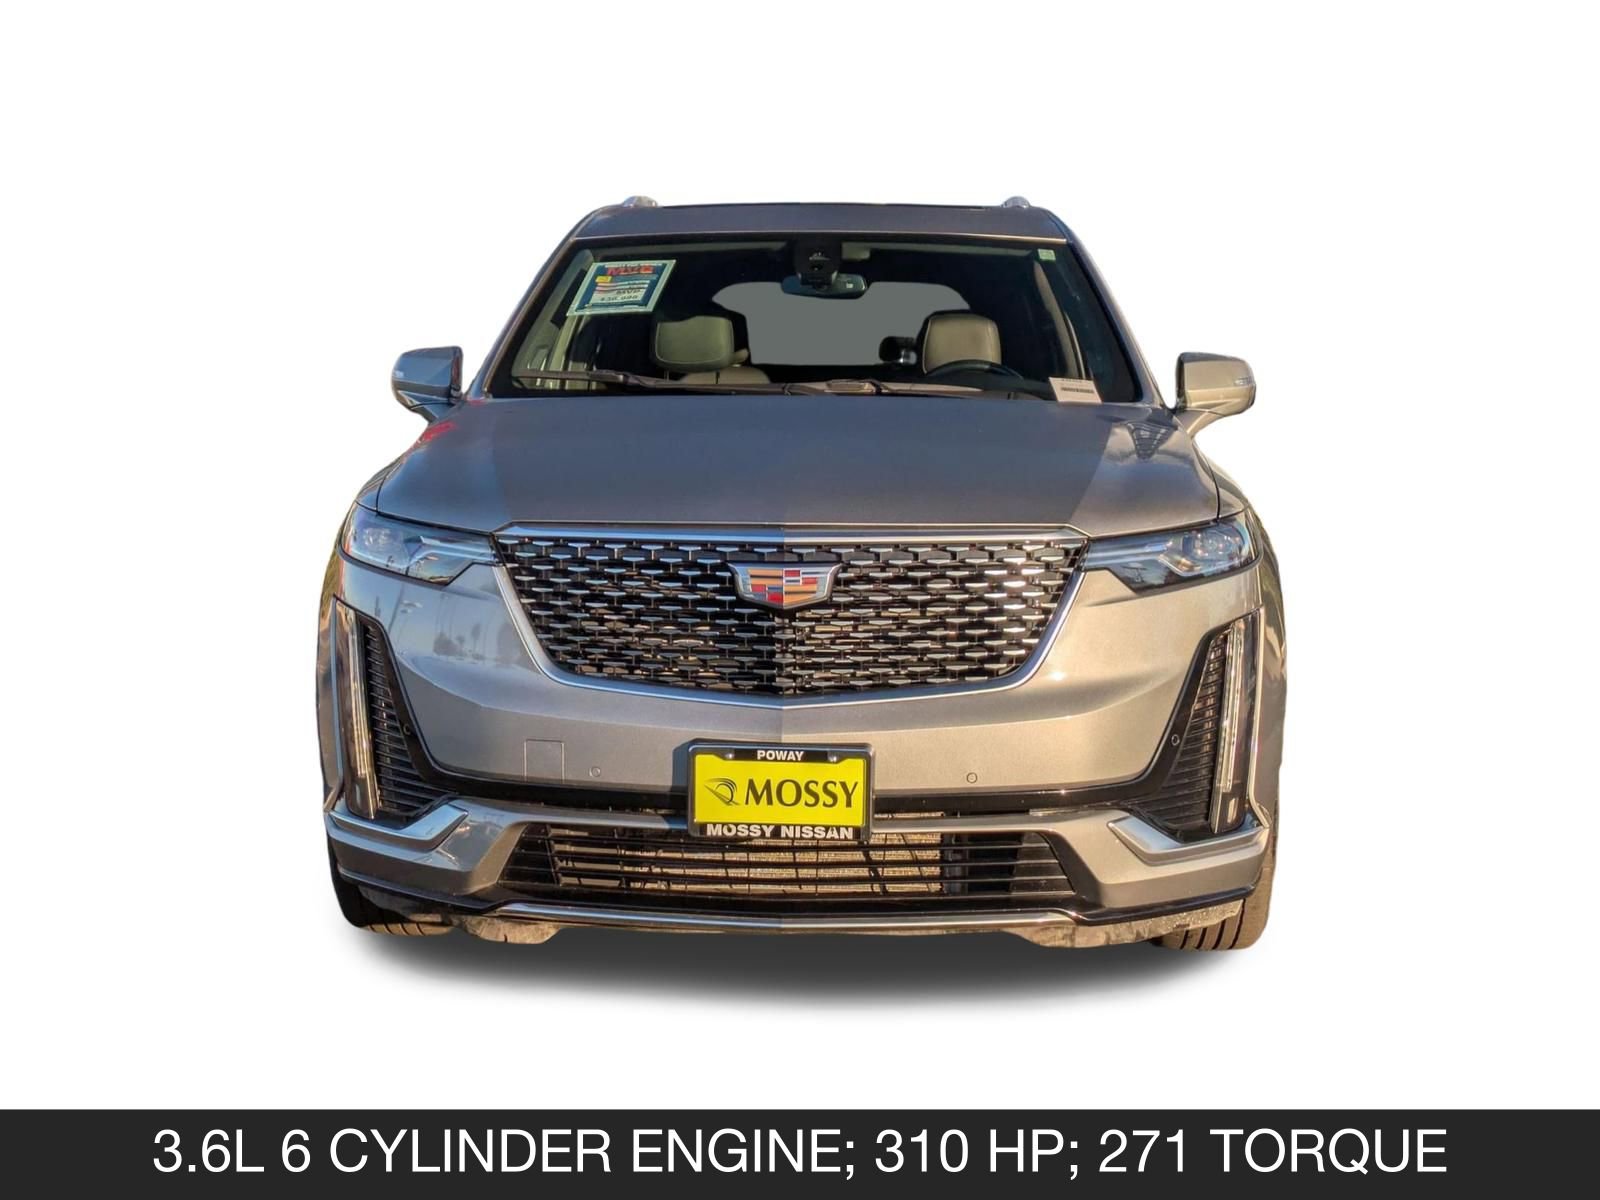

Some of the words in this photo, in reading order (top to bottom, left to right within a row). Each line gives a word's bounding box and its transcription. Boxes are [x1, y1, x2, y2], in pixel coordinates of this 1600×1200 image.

[756, 750, 805, 761] POWAY
[745, 778, 858, 808] MOSSY
[706, 824, 775, 838] MOSSY
[780, 824, 854, 840] NISSAN
